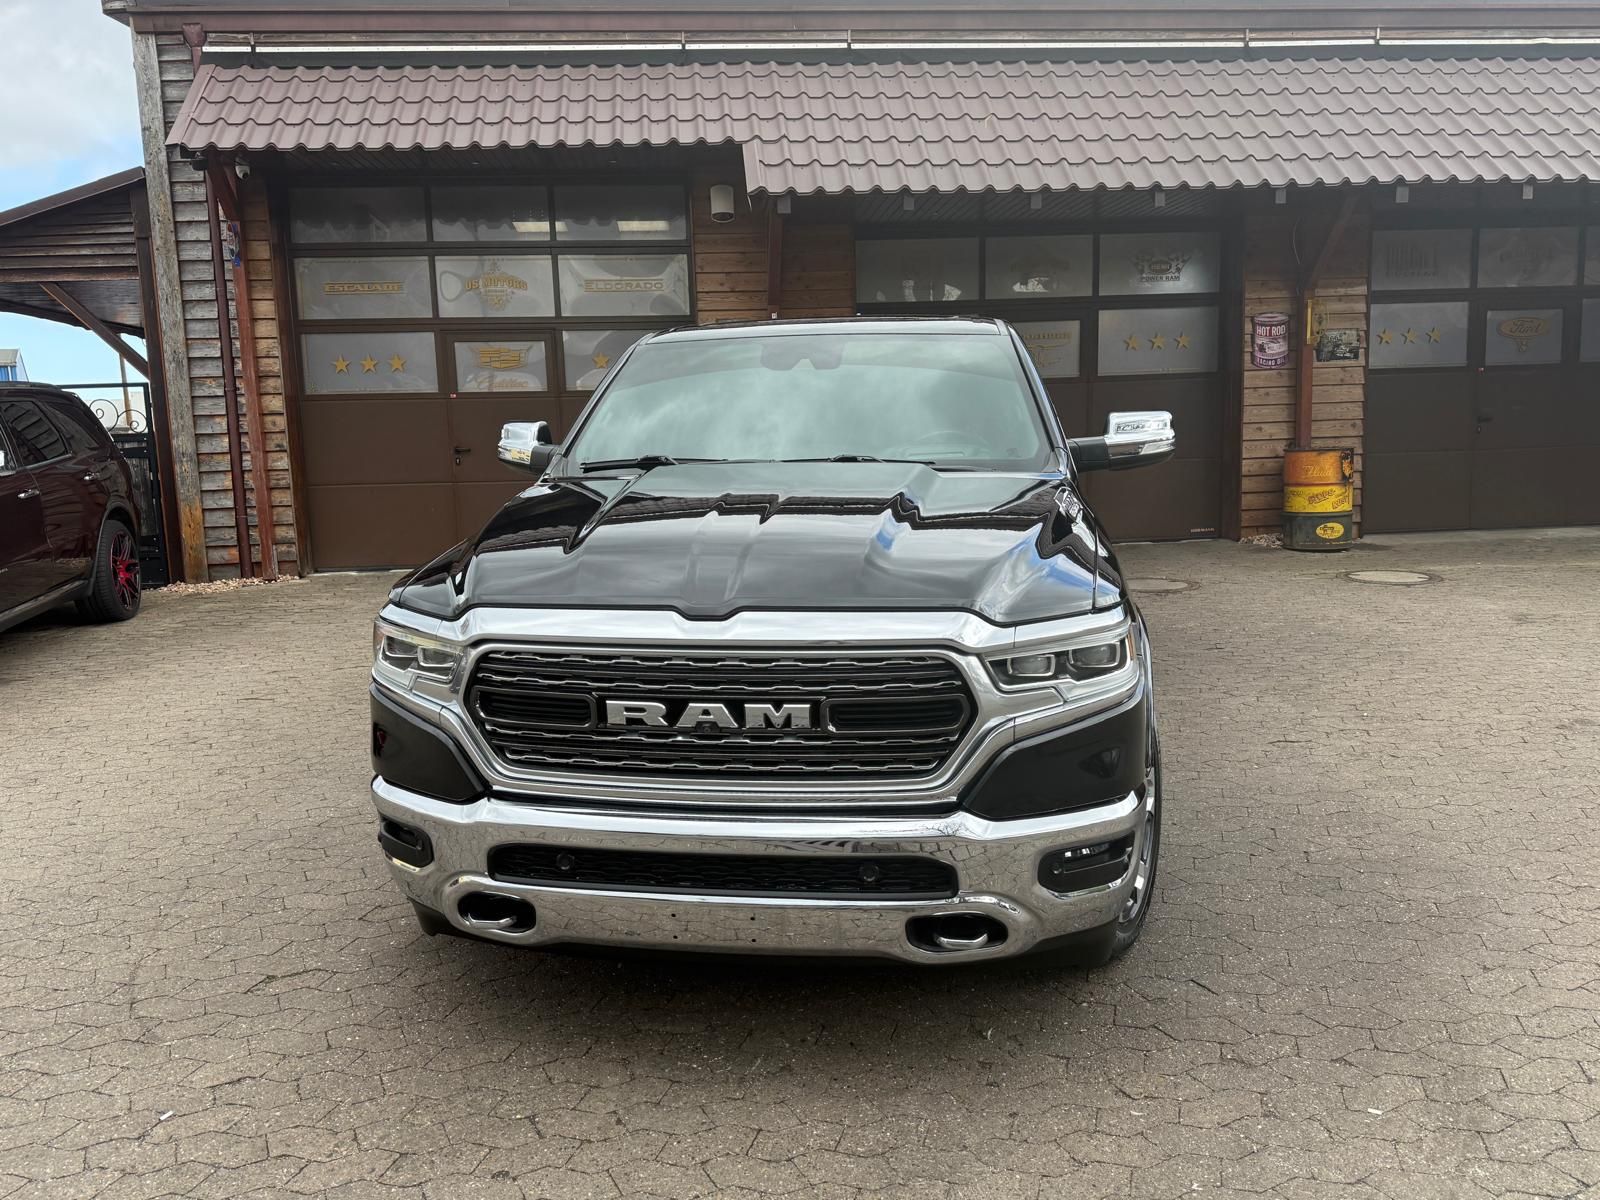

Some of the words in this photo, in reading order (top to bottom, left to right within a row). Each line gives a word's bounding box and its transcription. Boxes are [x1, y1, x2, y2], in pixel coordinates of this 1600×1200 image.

[1165, 274, 1181, 282] RAM
[583, 281, 664, 291] ELDORADO
[1256, 325, 1270, 336] HOT
[1271, 325, 1286, 336] ROD
[606, 700, 811, 728] RAM
